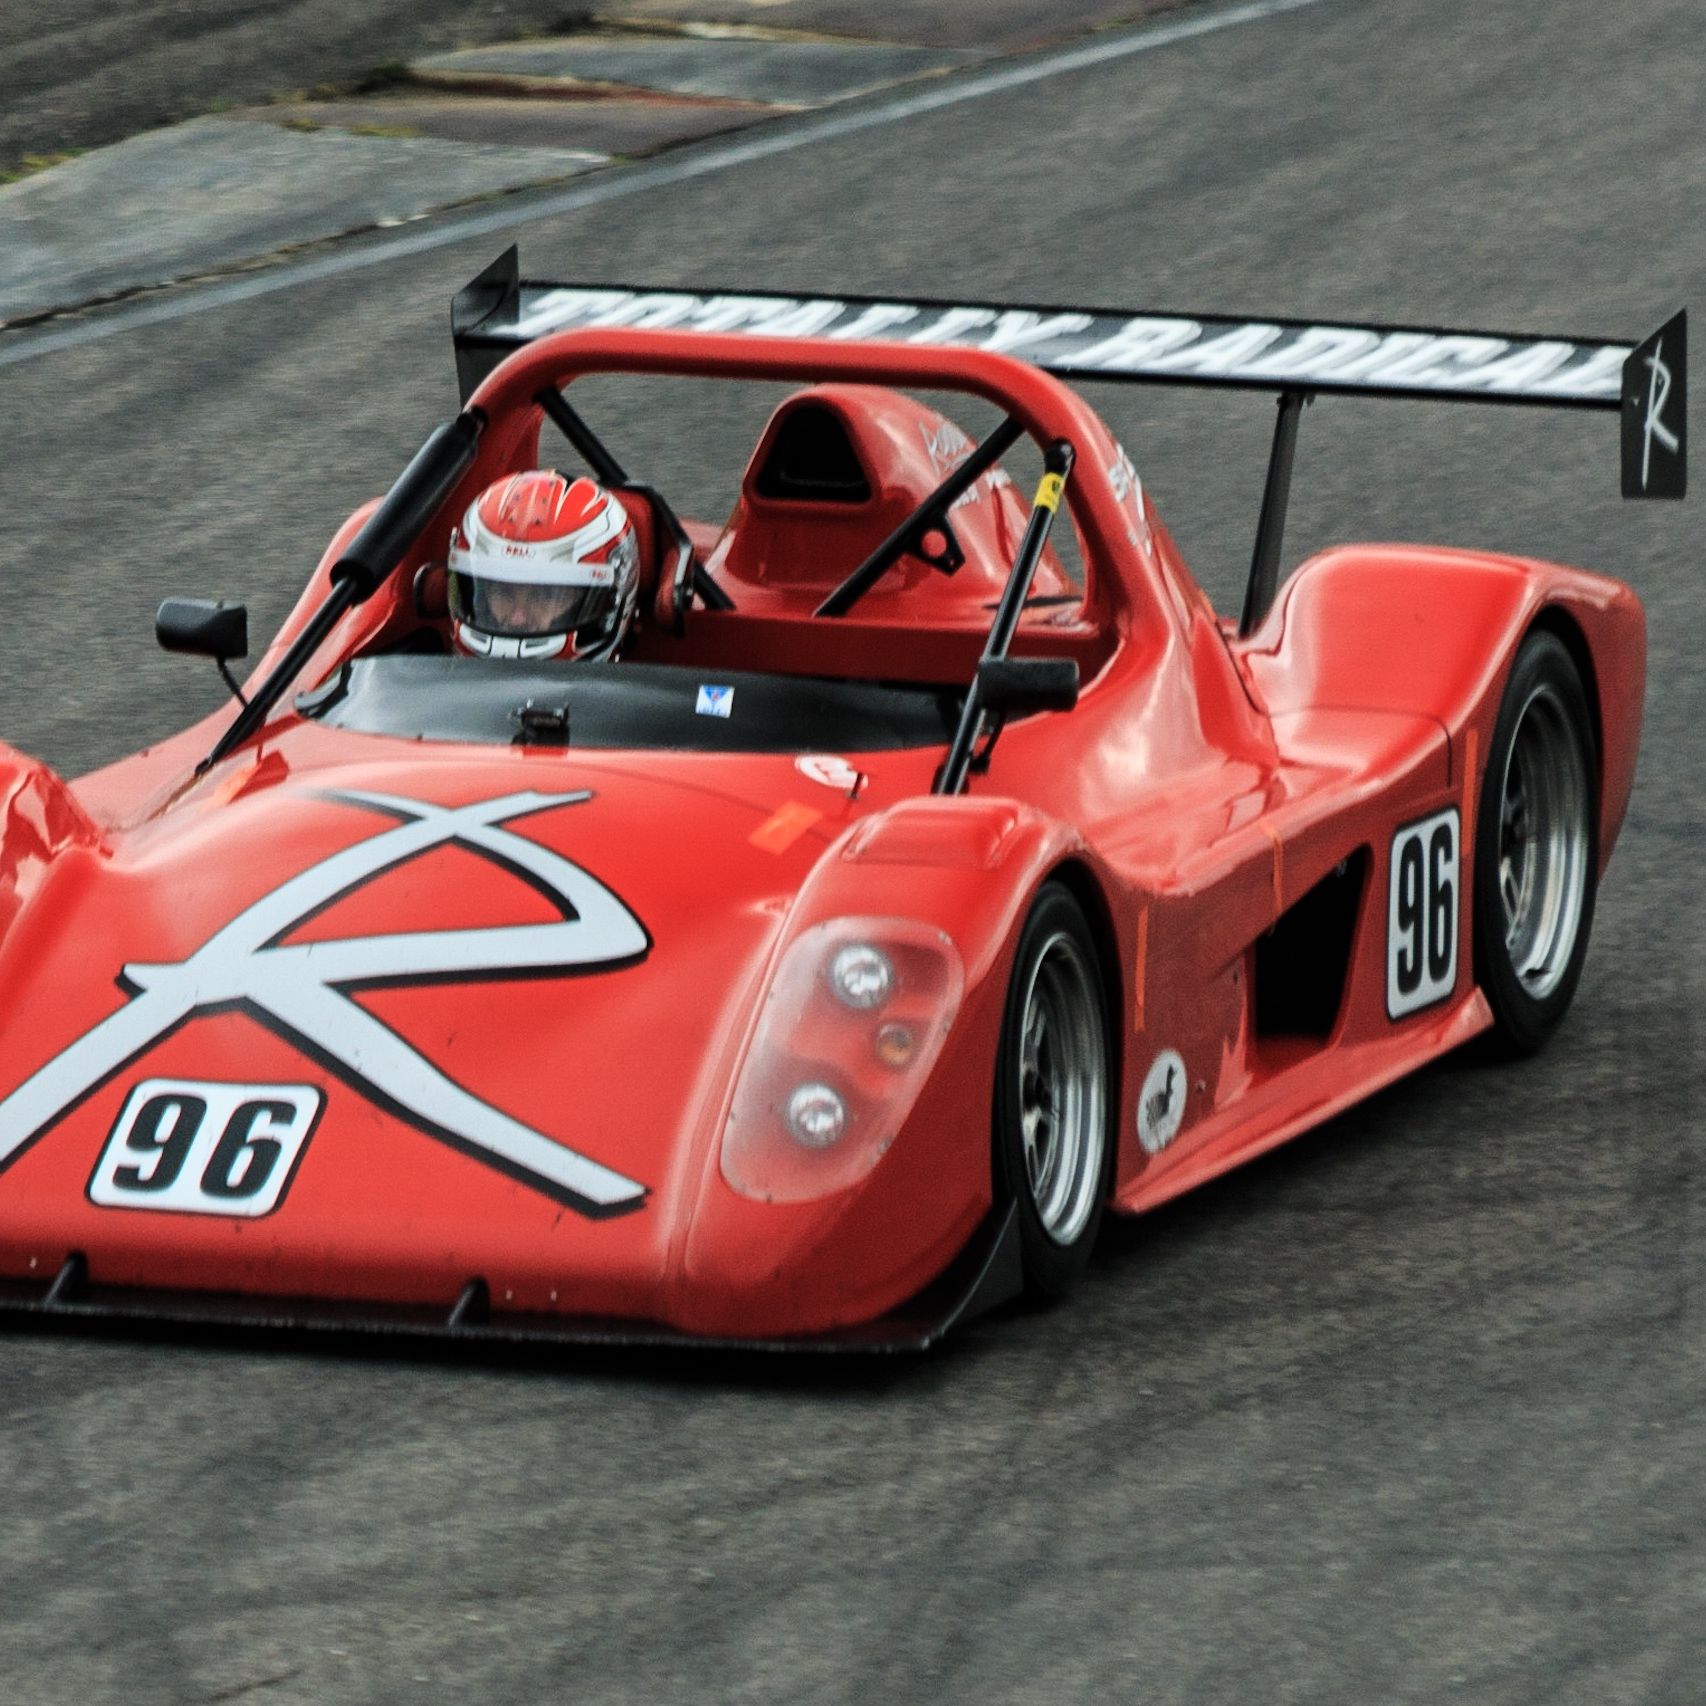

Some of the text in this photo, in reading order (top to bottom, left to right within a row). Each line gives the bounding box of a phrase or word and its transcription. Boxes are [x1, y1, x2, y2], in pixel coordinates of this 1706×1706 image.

[1050, 317, 1632, 398] RADICAL
[1396, 822, 1454, 997] 96
[112, 1094, 297, 1199] 96
